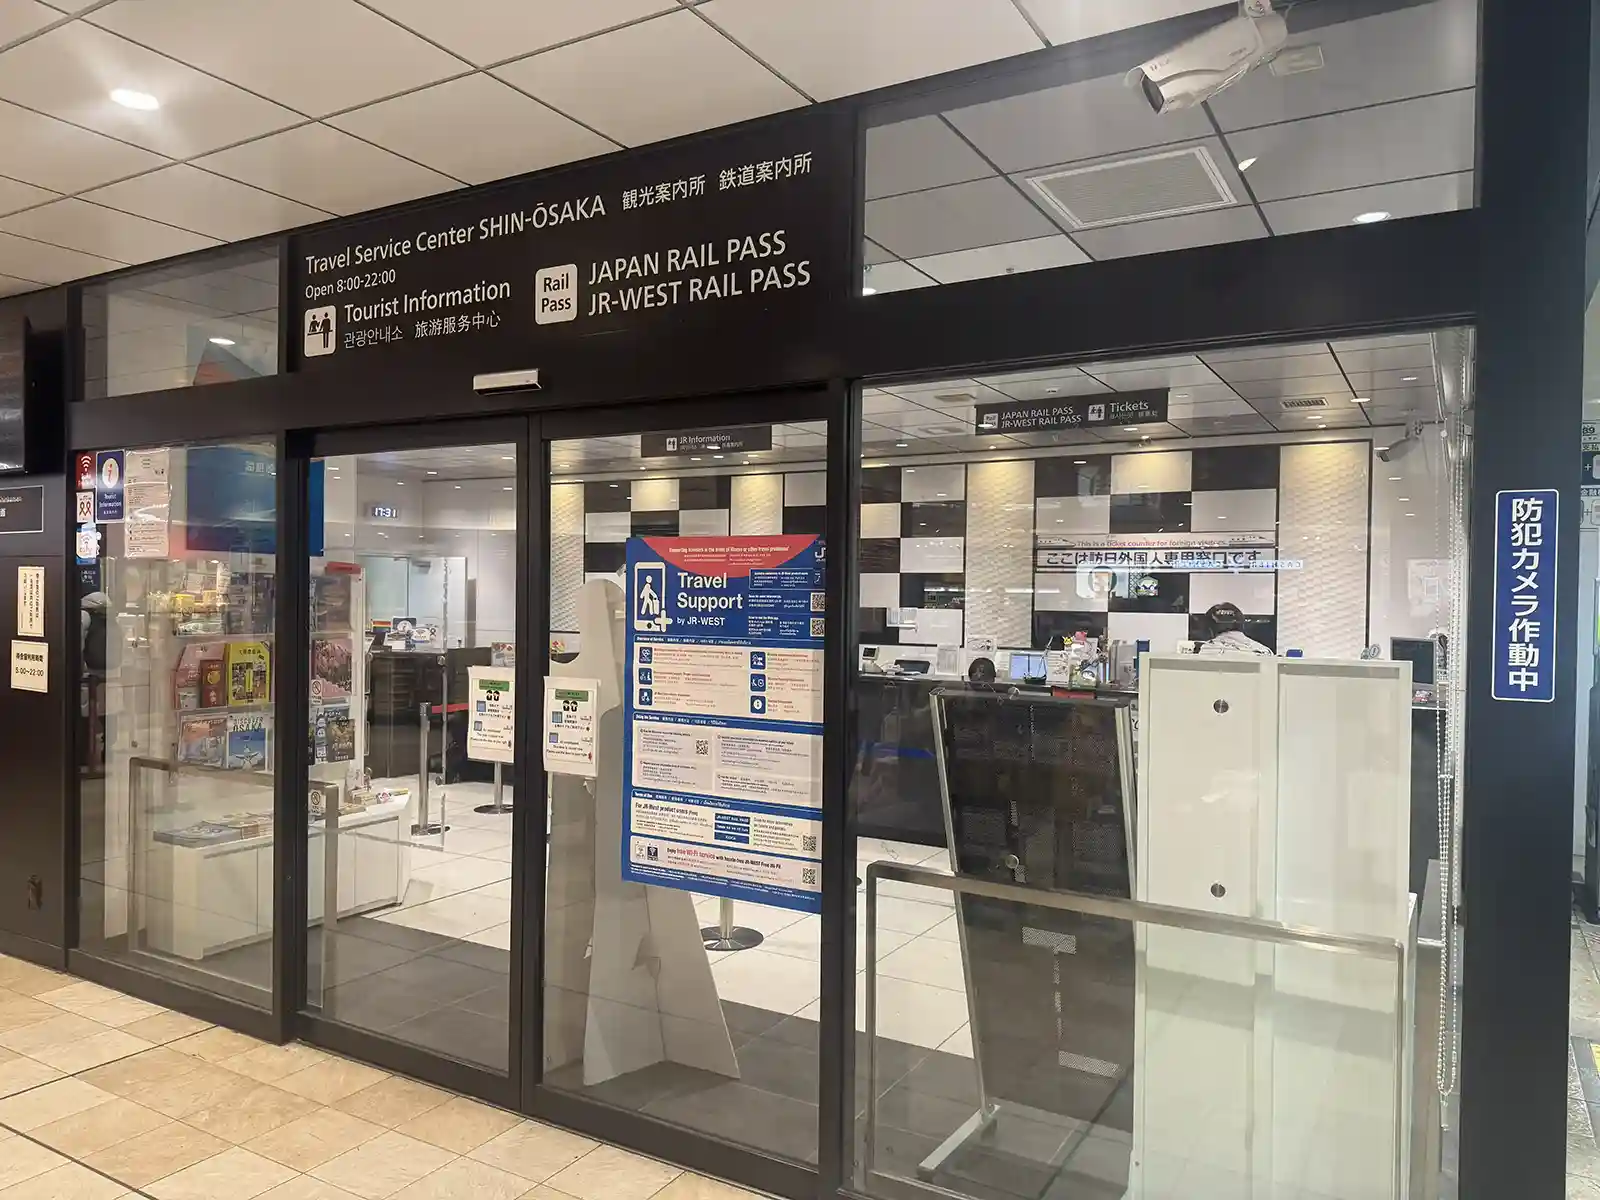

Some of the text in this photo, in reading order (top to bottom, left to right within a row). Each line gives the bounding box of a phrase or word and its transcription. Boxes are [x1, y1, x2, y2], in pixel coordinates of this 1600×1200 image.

[622, 152, 812, 210] 観光案内所 鉄道案内所
[306, 195, 606, 274] Travel Service Center SHIN-ŌSAKA
[588, 229, 787, 286] JAPAN RAIL PASS
[306, 269, 396, 300] Open 8:00-22:00
[543, 274, 569, 293] Rail
[588, 260, 811, 316] JR-WEST RAIL PASS
[344, 280, 511, 323] Tourist Information
[541, 295, 571, 314] Pass
[415, 310, 501, 339] 旅游服务中心
[344, 326, 403, 349] 관광안내소
[1001, 406, 1074, 420] JAPAN RAIL PASS
[1110, 401, 1149, 412] Tickets
[1001, 418, 1037, 429] JR-WEST
[1039, 417, 1058, 425] RAIL
[1060, 415, 1082, 424] PASS
[680, 434, 730, 444] JR Information
[374, 507, 397, 518] 17:31
[1047, 550, 1261, 565] ここは訪日外国人専用窓口です
[677, 572, 727, 588] Travel
[677, 592, 743, 612] Support
[1508, 497, 1544, 693] 防犯カメラ作動中
[676, 616, 726, 626] by JR-WEST
